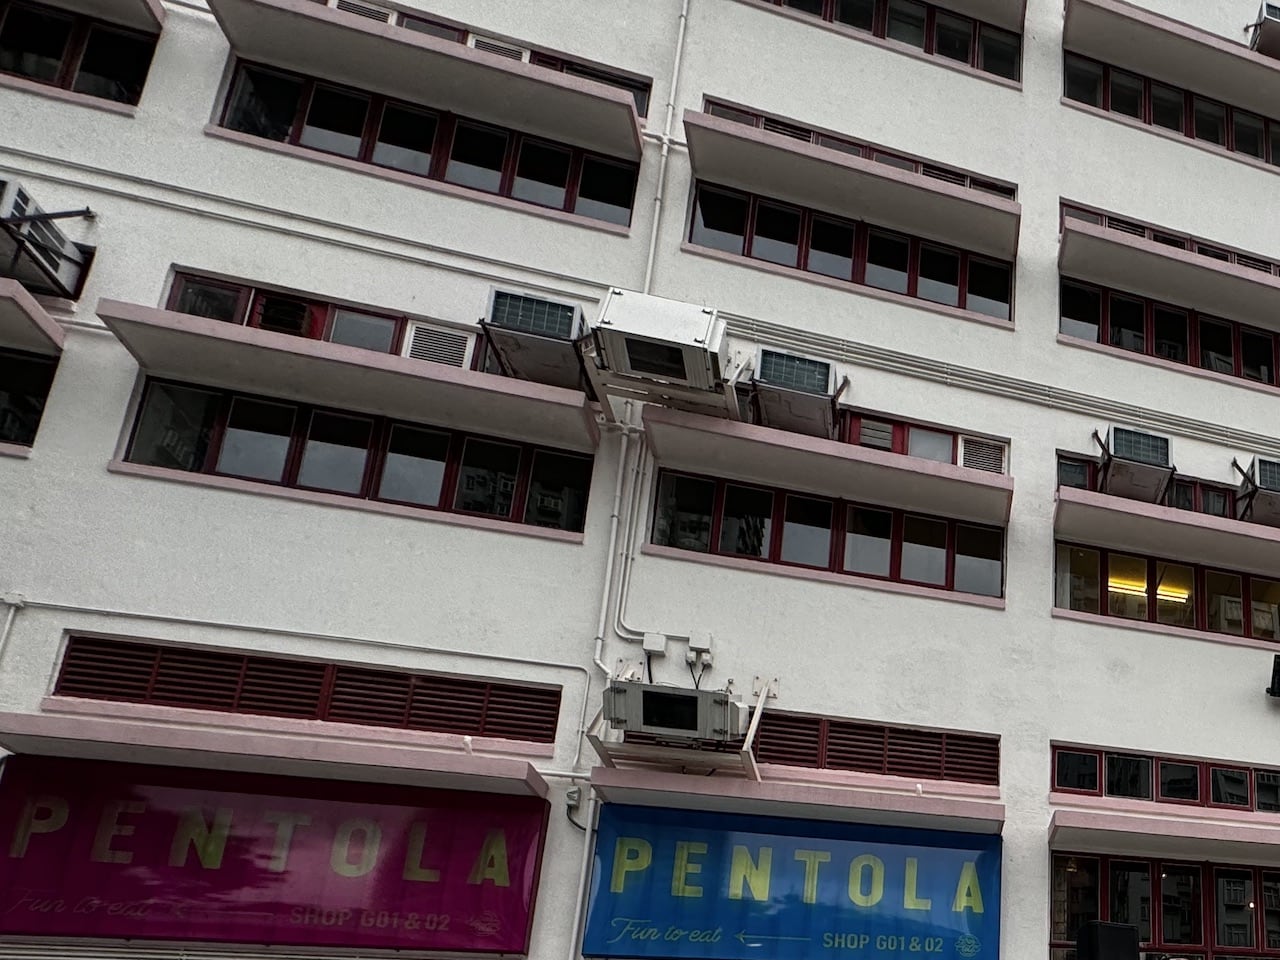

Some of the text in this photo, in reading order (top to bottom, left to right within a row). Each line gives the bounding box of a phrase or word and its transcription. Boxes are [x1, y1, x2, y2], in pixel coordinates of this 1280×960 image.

[8, 794, 512, 887] PENTOLA
[610, 837, 984, 913] PENTOLA
[290, 906, 351, 927] SHOP
[404, 912, 421, 930] &
[425, 914, 450, 932] 02
[607, 918, 722, 943] Fun to eat
[823, 932, 869, 949] SHOP
[876, 935, 905, 950] G01
[909, 937, 921, 952] &
[925, 937, 943, 952] 02
